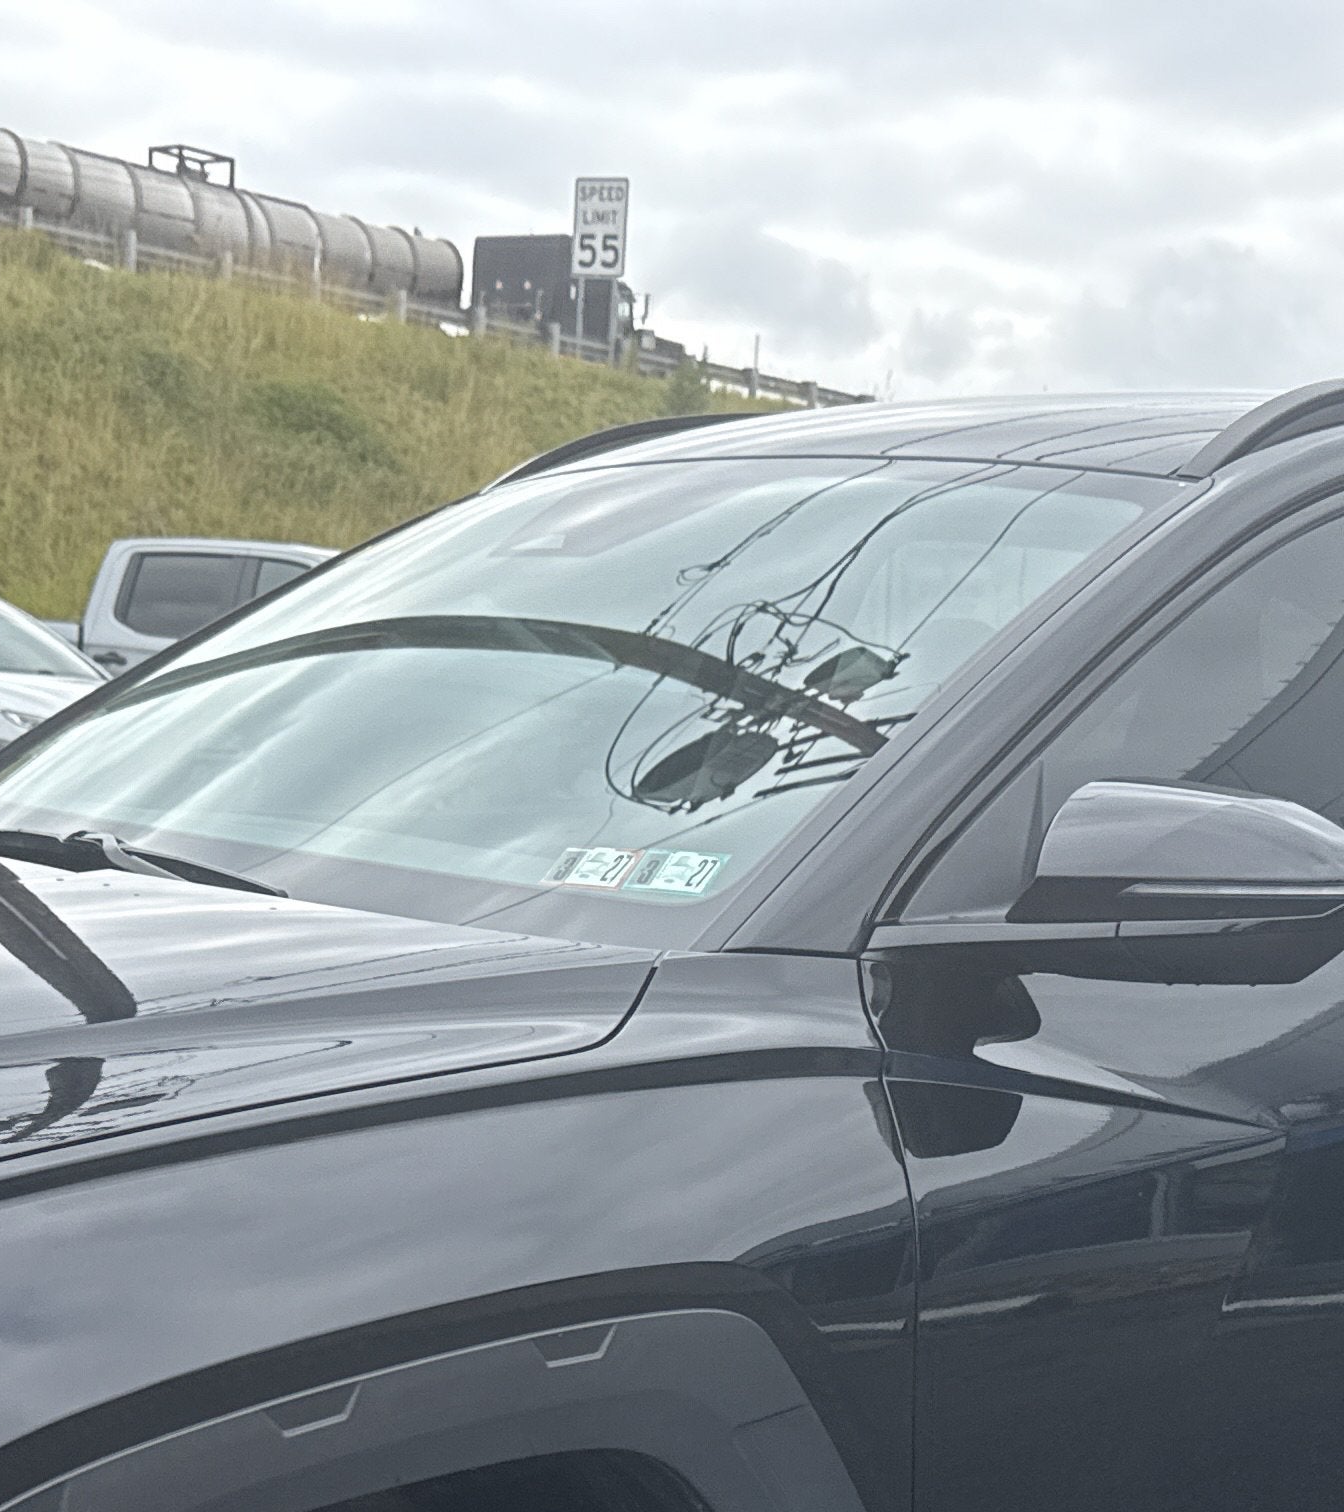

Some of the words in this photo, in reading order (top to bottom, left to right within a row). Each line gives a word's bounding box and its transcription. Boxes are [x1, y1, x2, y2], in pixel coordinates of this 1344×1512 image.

[580, 186, 625, 202] SPEED
[582, 210, 618, 225] LIMIT
[578, 234, 619, 268] 55
[600, 855, 634, 883] 27
[636, 860, 660, 884] 3
[685, 859, 719, 888] 27
